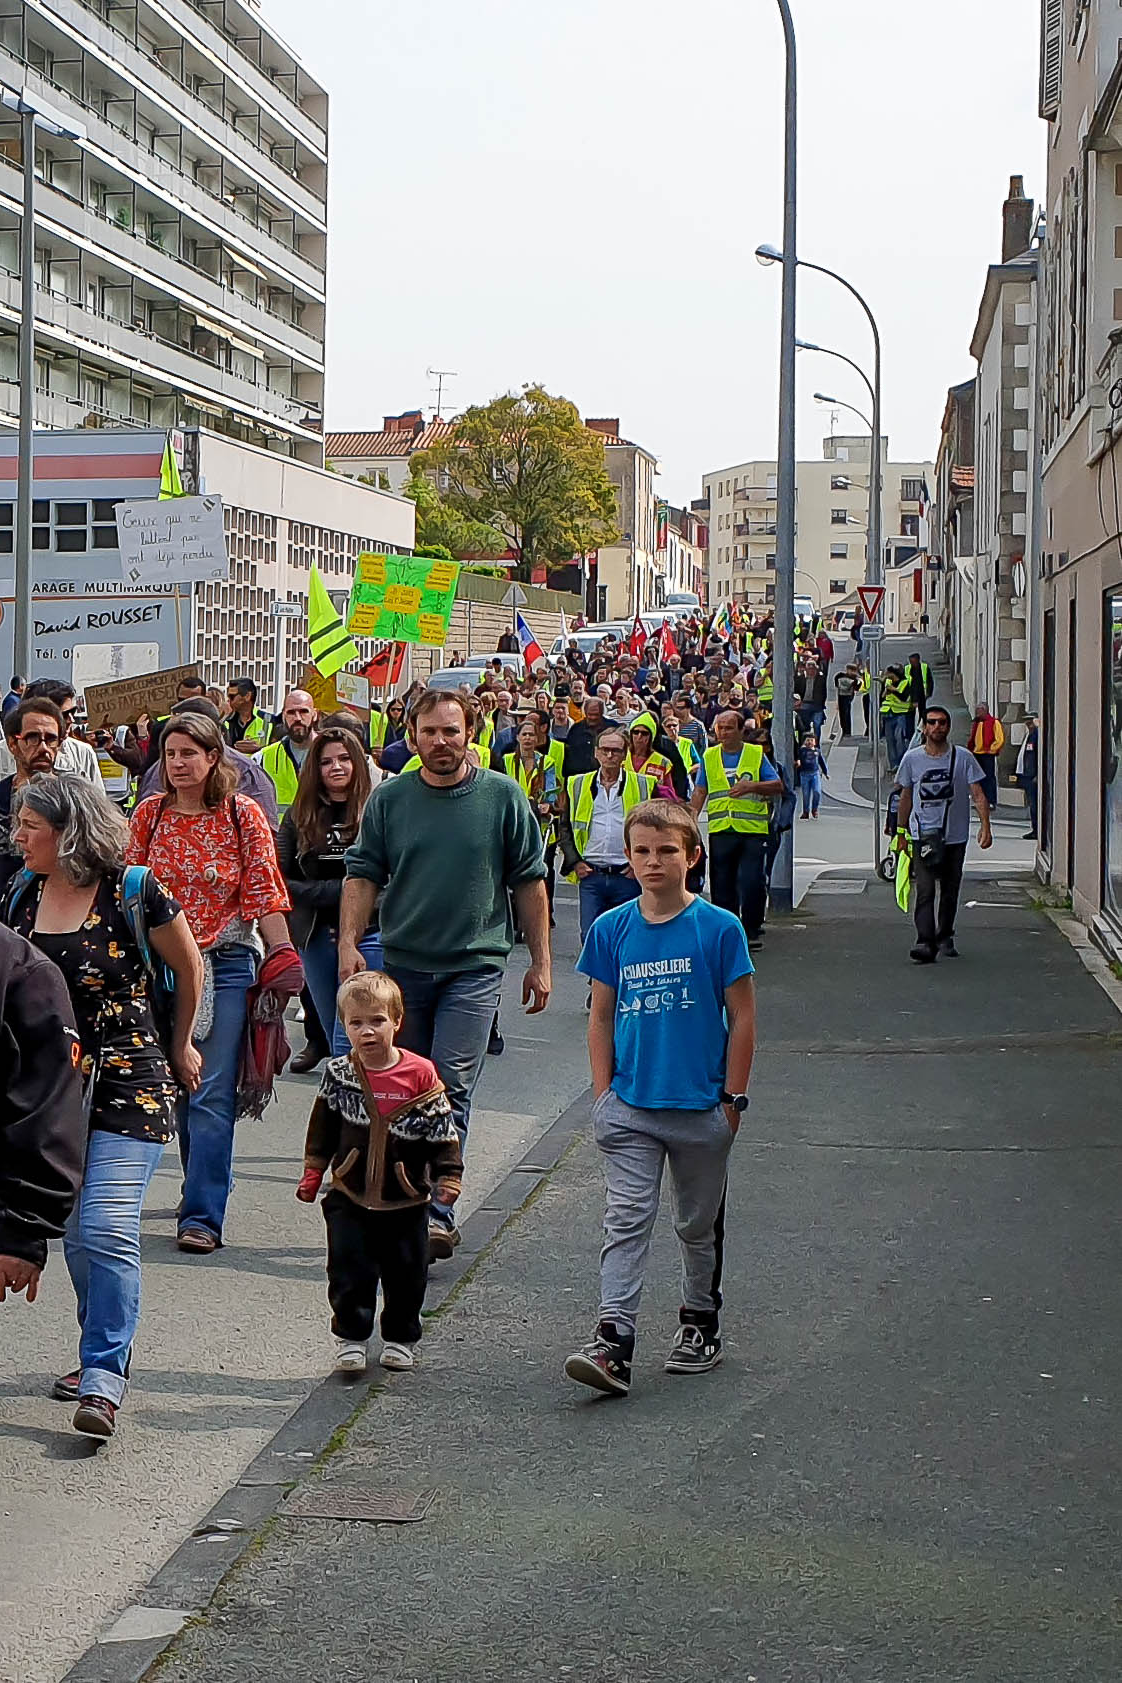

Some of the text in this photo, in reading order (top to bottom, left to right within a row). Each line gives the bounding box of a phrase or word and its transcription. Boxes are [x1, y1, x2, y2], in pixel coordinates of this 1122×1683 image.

[123, 510, 157, 528] Ceux
[165, 515, 182, 529] qui
[182, 546, 214, 566] perdu
[32, 582, 75, 593] ARAGE
[33, 604, 162, 636] David ROUSSET
[35, 649, 57, 659] Tél.
